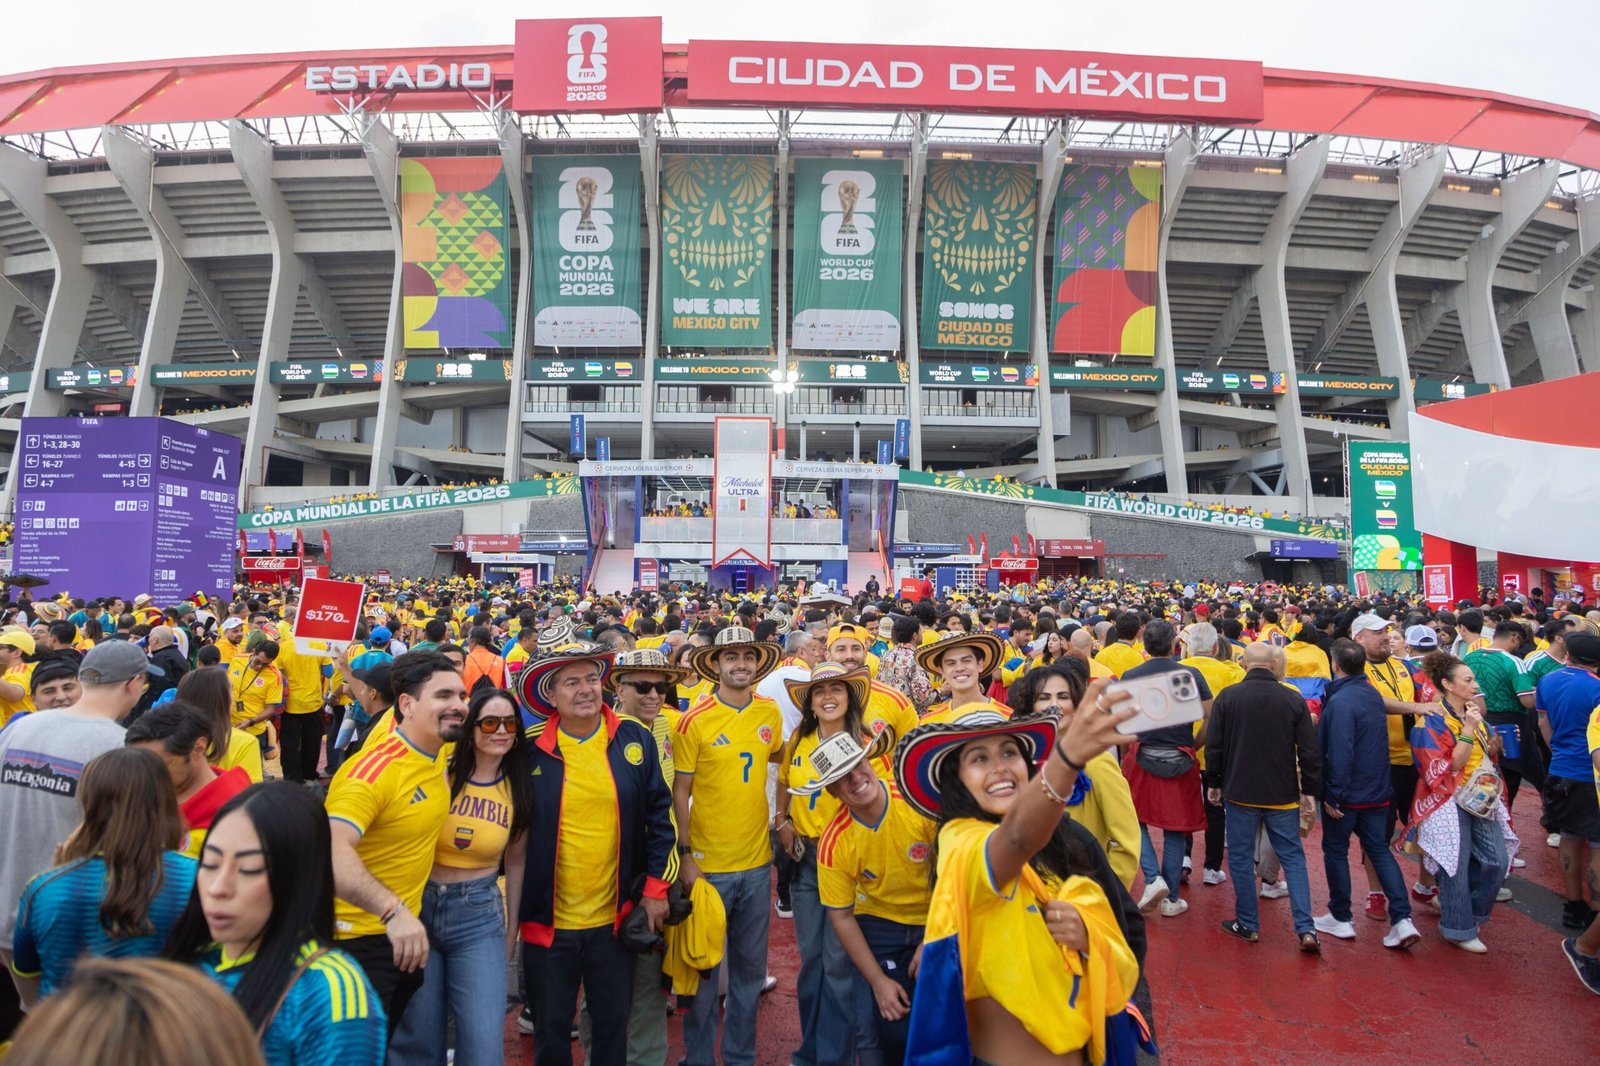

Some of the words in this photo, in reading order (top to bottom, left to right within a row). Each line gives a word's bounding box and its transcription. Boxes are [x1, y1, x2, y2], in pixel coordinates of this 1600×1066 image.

[306, 63, 491, 91] ESTADIO
[729, 56, 924, 90] CIUDAD
[949, 63, 1015, 93] DE
[1035, 62, 1227, 104] MÉXICO
[566, 92, 607, 101] 2026
[575, 235, 599, 244] FIFA
[836, 238, 860, 248] FIFA
[559, 255, 614, 271] COPA
[820, 258, 854, 267] WORLD
[855, 259, 874, 267] CUP
[559, 272, 614, 282] MUNDIAL
[819, 268, 874, 281] 2026
[559, 284, 615, 296] 2026
[672, 297, 710, 315] WE
[713, 297, 760, 315] ARE
[938, 301, 1015, 320] SOMOS
[672, 317, 726, 329] MEXICO
[729, 317, 760, 329] CITY
[937, 320, 993, 333] CIUDAD
[995, 322, 1013, 334] DE
[937, 331, 1013, 346] MÉXICO
[183, 370, 227, 378] MEXICO
[229, 369, 257, 377] CITY
[1082, 373, 1129, 382] MEXICO
[1130, 374, 1158, 383] CITY
[1324, 381, 1367, 389] MEXICO
[1369, 382, 1394, 391] CITY
[197, 428, 208, 436] FIFA
[43, 441, 57, 449] 1-3,
[58, 441, 80, 449] 28-30
[42, 460, 63, 468] 16-27
[118, 460, 136, 468] 4-15
[212, 456, 227, 480] A
[653, 464, 683, 472] SUPERIOR
[1367, 468, 1404, 476] MÉXICO
[40, 480, 54, 488] 4-7
[122, 480, 135, 488] 1-3
[721, 477, 764, 489] Michelob
[727, 488, 760, 496] ULTRA
[251, 510, 294, 526] COPA
[296, 501, 367, 521] MUNDIAL
[370, 498, 390, 513] DE
[393, 497, 414, 510] LA
[416, 491, 451, 508] FIFA
[453, 485, 511, 503] 2026
[1085, 494, 1118, 511] FIFA
[1120, 499, 1175, 517] WORLD
[1178, 506, 1210, 521] CUP
[1211, 511, 1265, 529] 2026
[454, 541, 465, 551] 30
[1040, 546, 1045, 554] 1
[1274, 547, 1280, 555] 2
[255, 558, 286, 569] Coca-Cola
[1001, 559, 1027, 569] Coca-Cola
[305, 609, 345, 623] $170
[739, 752, 753, 783] 7
[4, 769, 71, 793] patagonia
